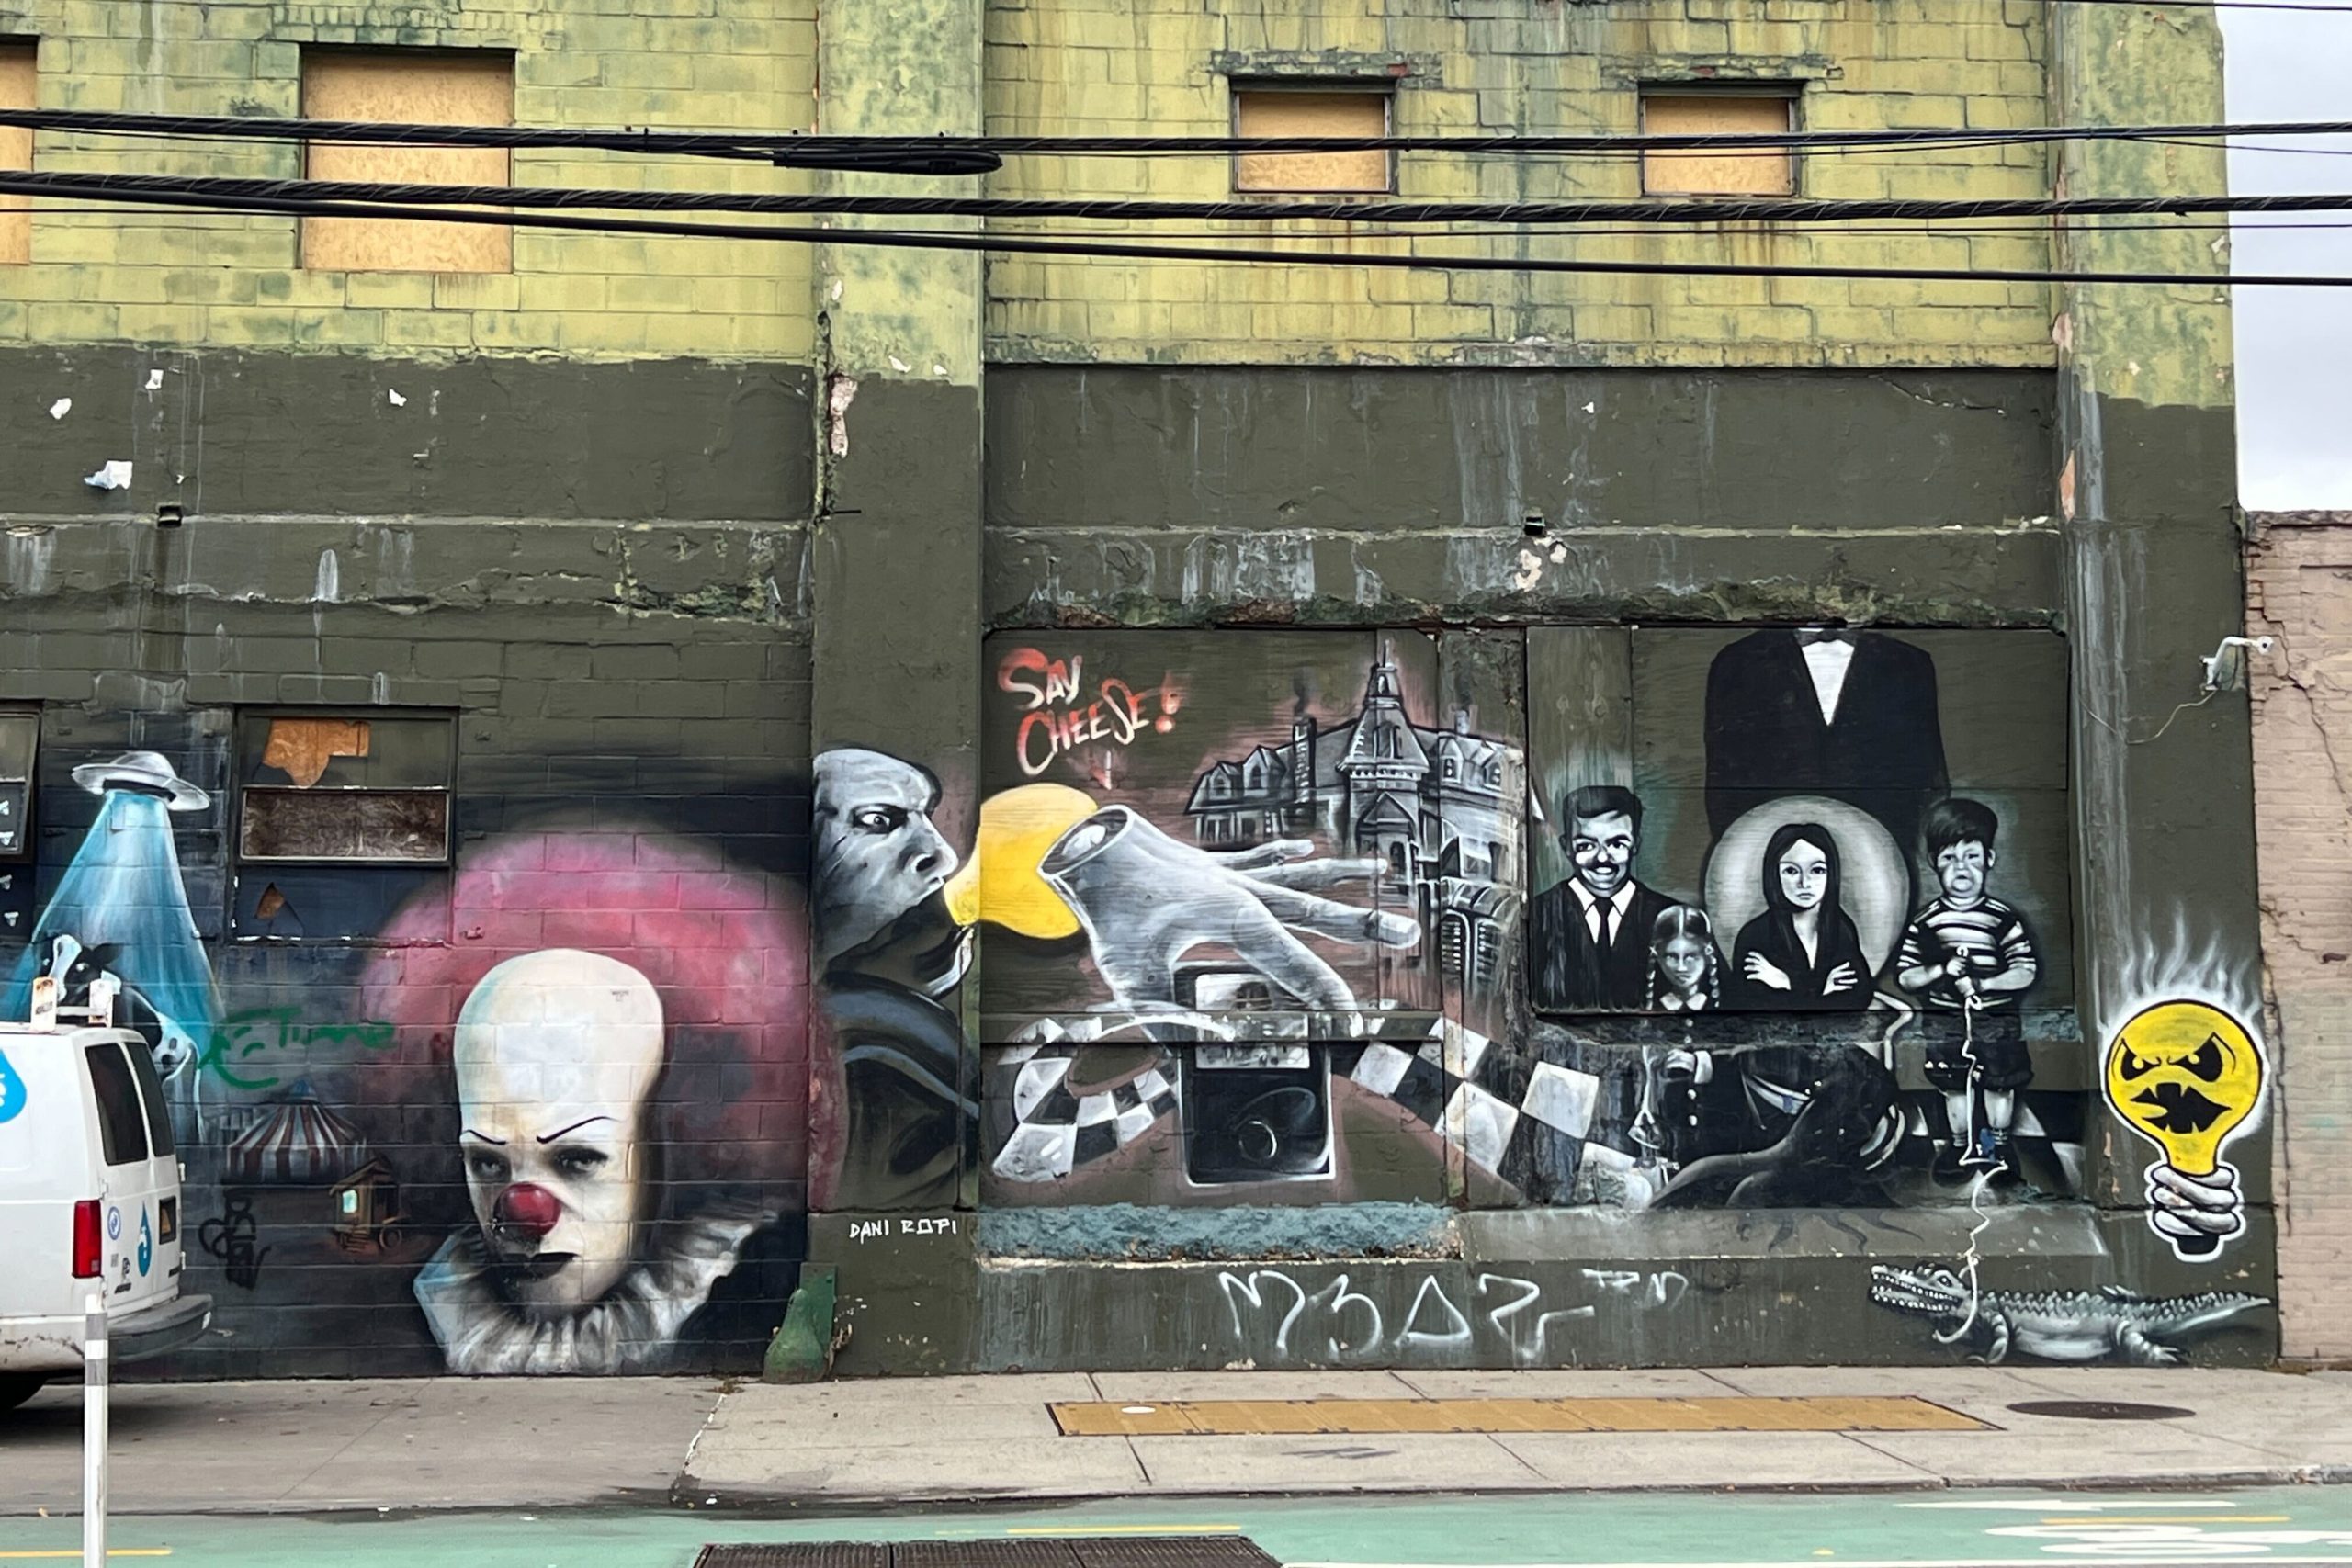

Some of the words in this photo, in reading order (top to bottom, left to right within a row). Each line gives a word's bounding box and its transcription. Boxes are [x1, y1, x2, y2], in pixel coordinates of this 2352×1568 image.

[998, 647, 1083, 710] SAY
[1016, 670, 1182, 775] CHEESE!
[849, 1219, 889, 1244] DANI
[900, 1217, 956, 1235] ROPI
